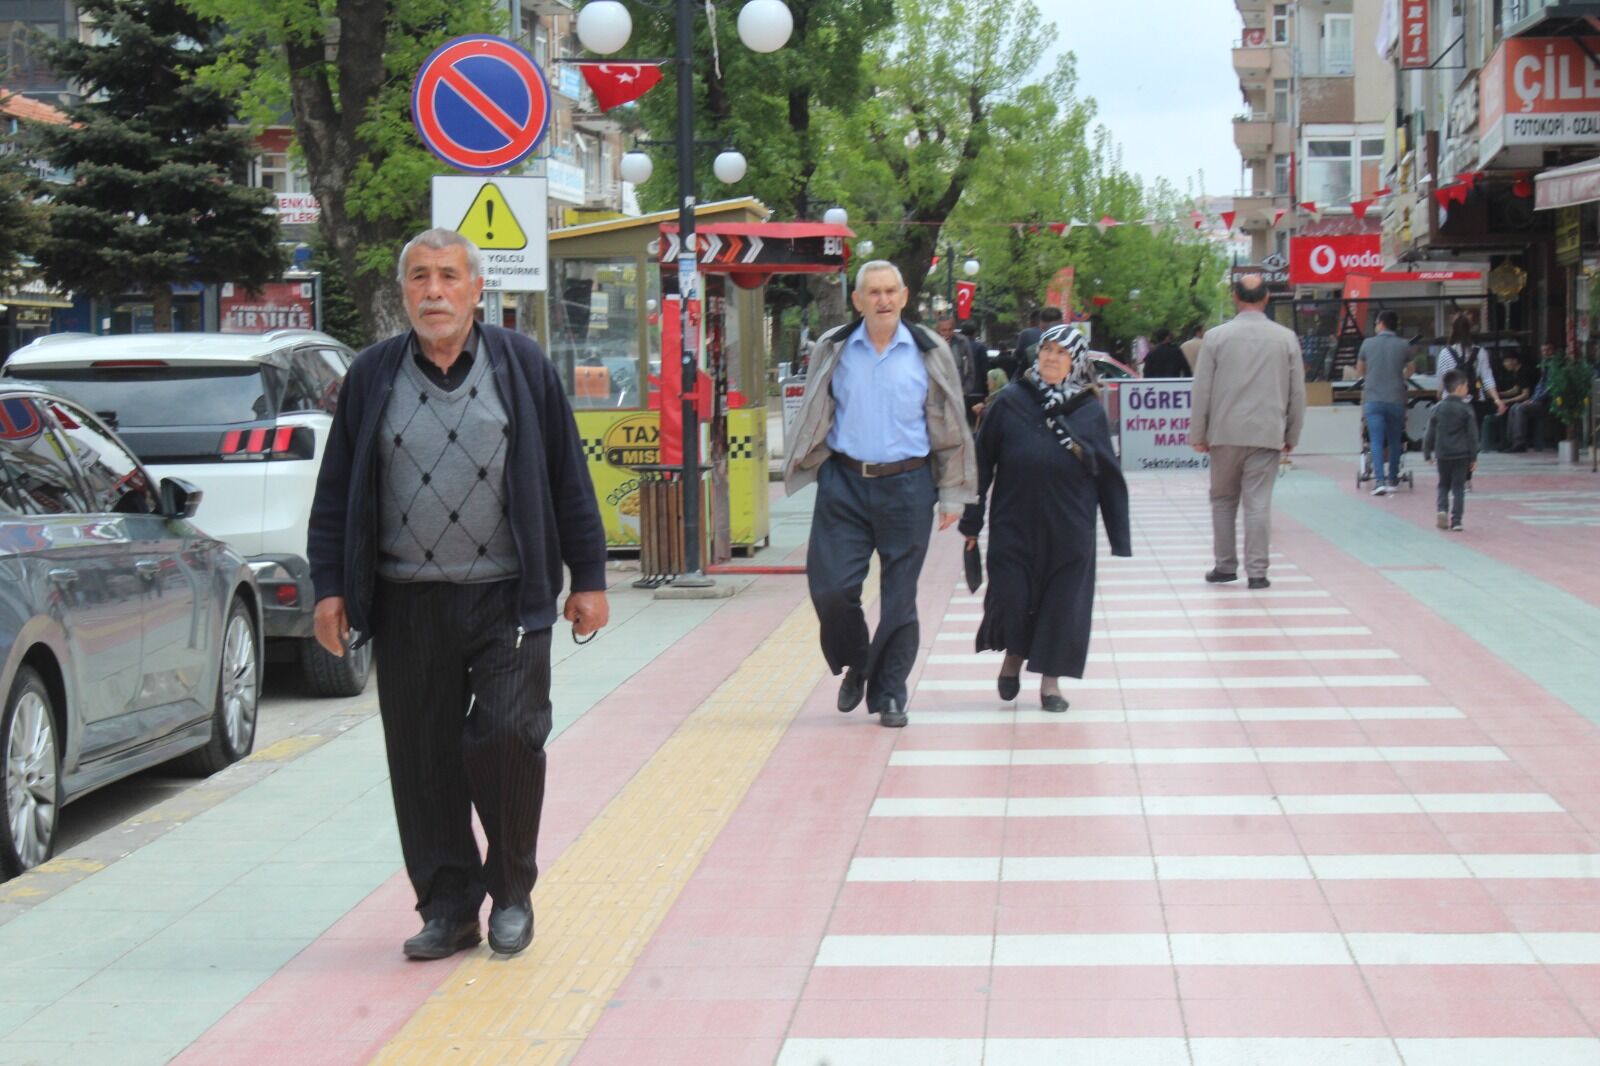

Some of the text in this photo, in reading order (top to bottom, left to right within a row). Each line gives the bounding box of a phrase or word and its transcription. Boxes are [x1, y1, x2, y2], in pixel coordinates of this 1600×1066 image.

[1514, 114, 1565, 136] FOTOKOPİ
[488, 254, 525, 262] YOLCU
[1339, 251, 1384, 268] voda
[487, 265, 540, 275] BİNDİRME
[1126, 415, 1167, 431] KİTAP
